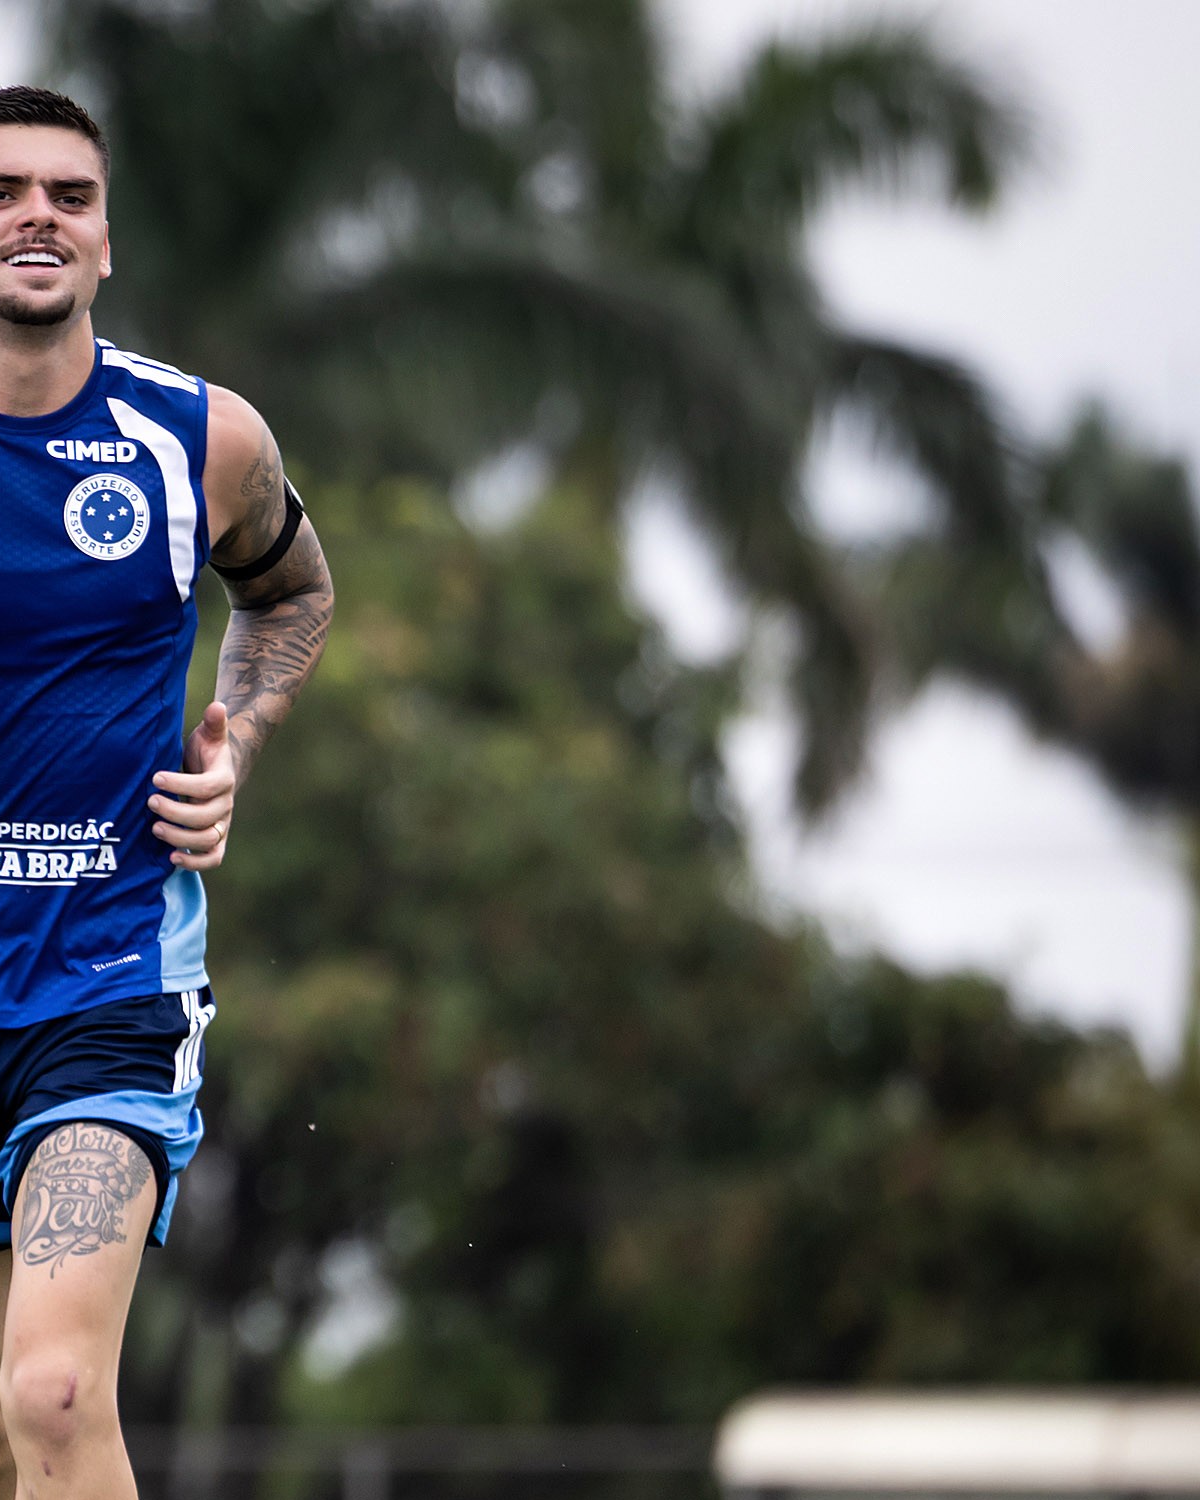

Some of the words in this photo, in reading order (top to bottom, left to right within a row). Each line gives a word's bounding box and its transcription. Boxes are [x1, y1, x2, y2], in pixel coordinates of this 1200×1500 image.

[45, 439, 138, 463] CIMED
[75, 479, 139, 502] CRUZEIRO
[70, 510, 114, 555] ESPORTE
[120, 510, 144, 551] CLUBE
[25, 844, 118, 879] BRAA
